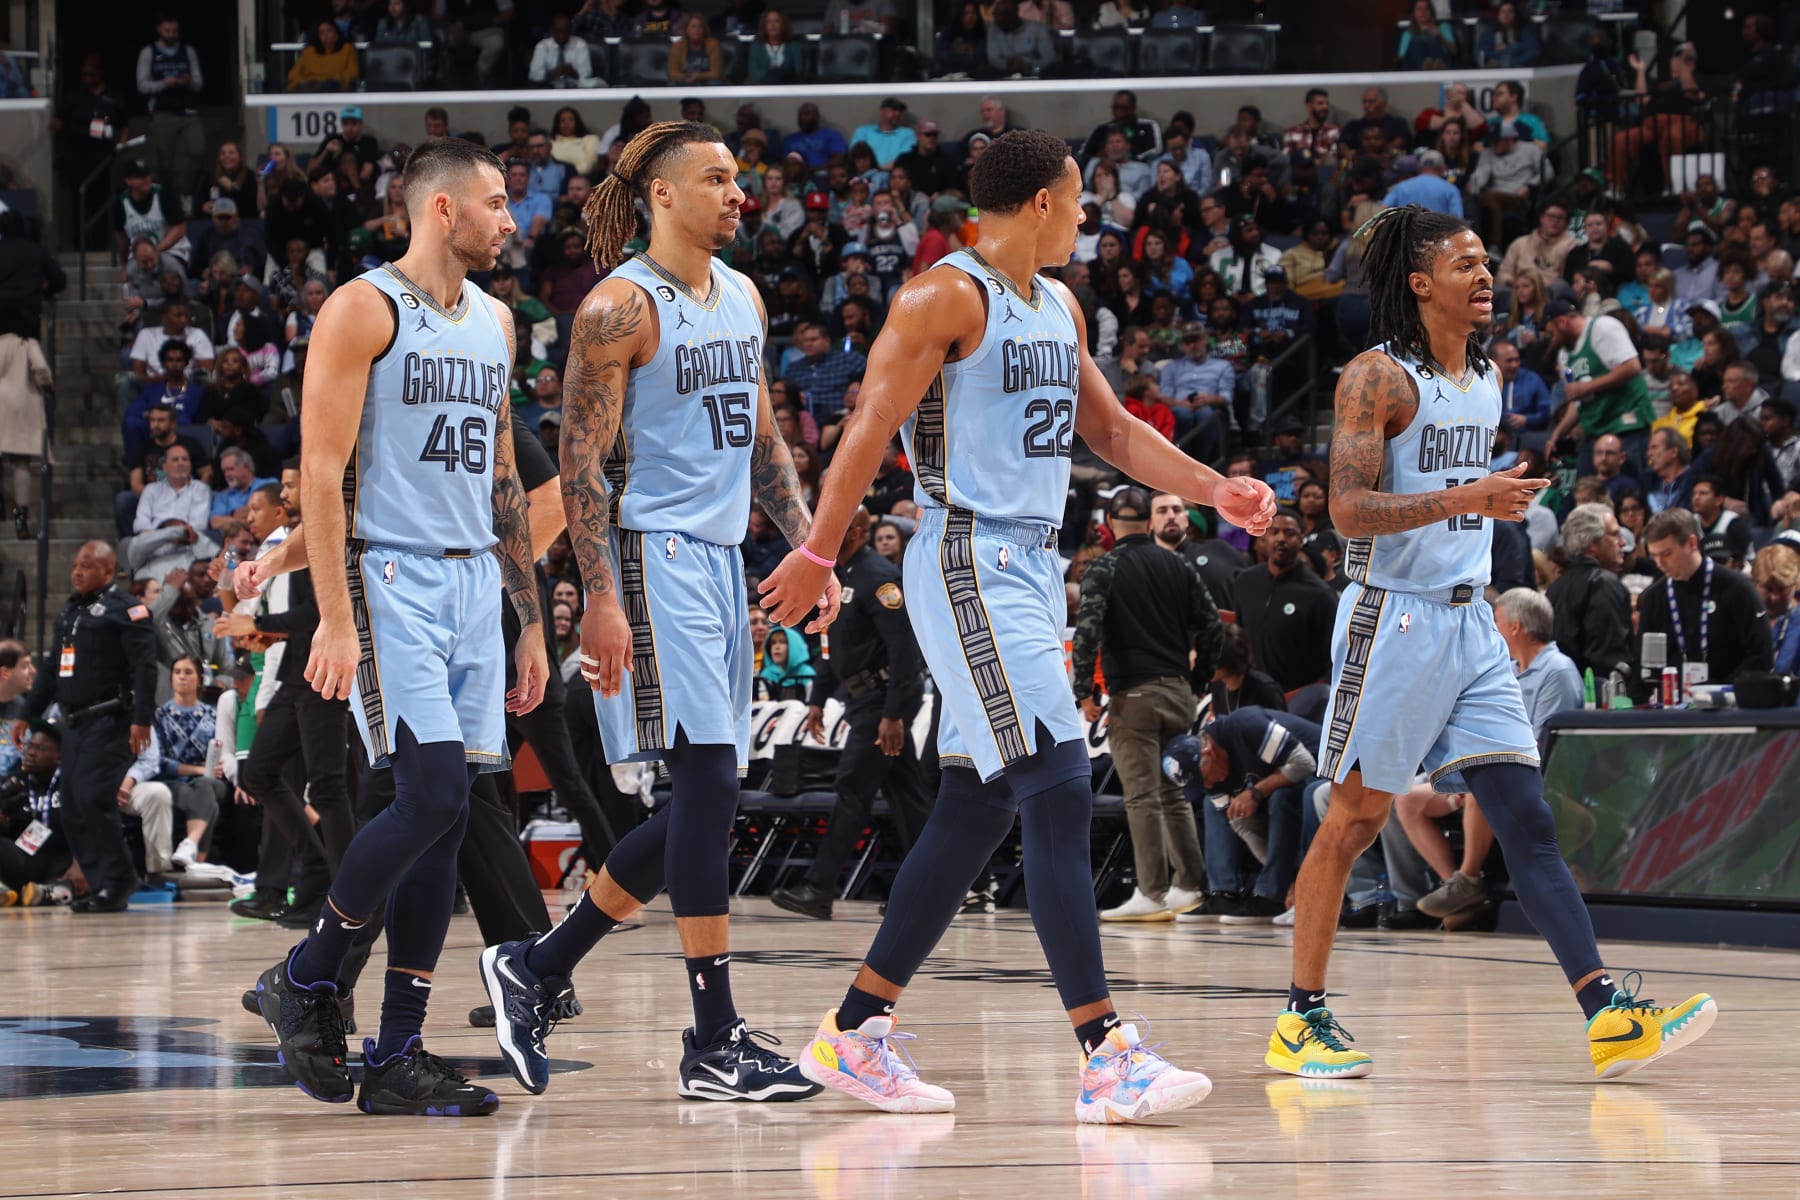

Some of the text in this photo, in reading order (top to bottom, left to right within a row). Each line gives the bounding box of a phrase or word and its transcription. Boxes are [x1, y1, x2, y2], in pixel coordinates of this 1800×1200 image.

[291, 111, 337, 137] 108
[402, 294, 417, 308] 6
[657, 287, 672, 300] 6
[402, 351, 505, 415] GRIZZLIES
[676, 335, 760, 395] GRIZZLIES
[418, 414, 487, 474] 46
[702, 392, 753, 450] 15
[1023, 398, 1073, 458] 22
